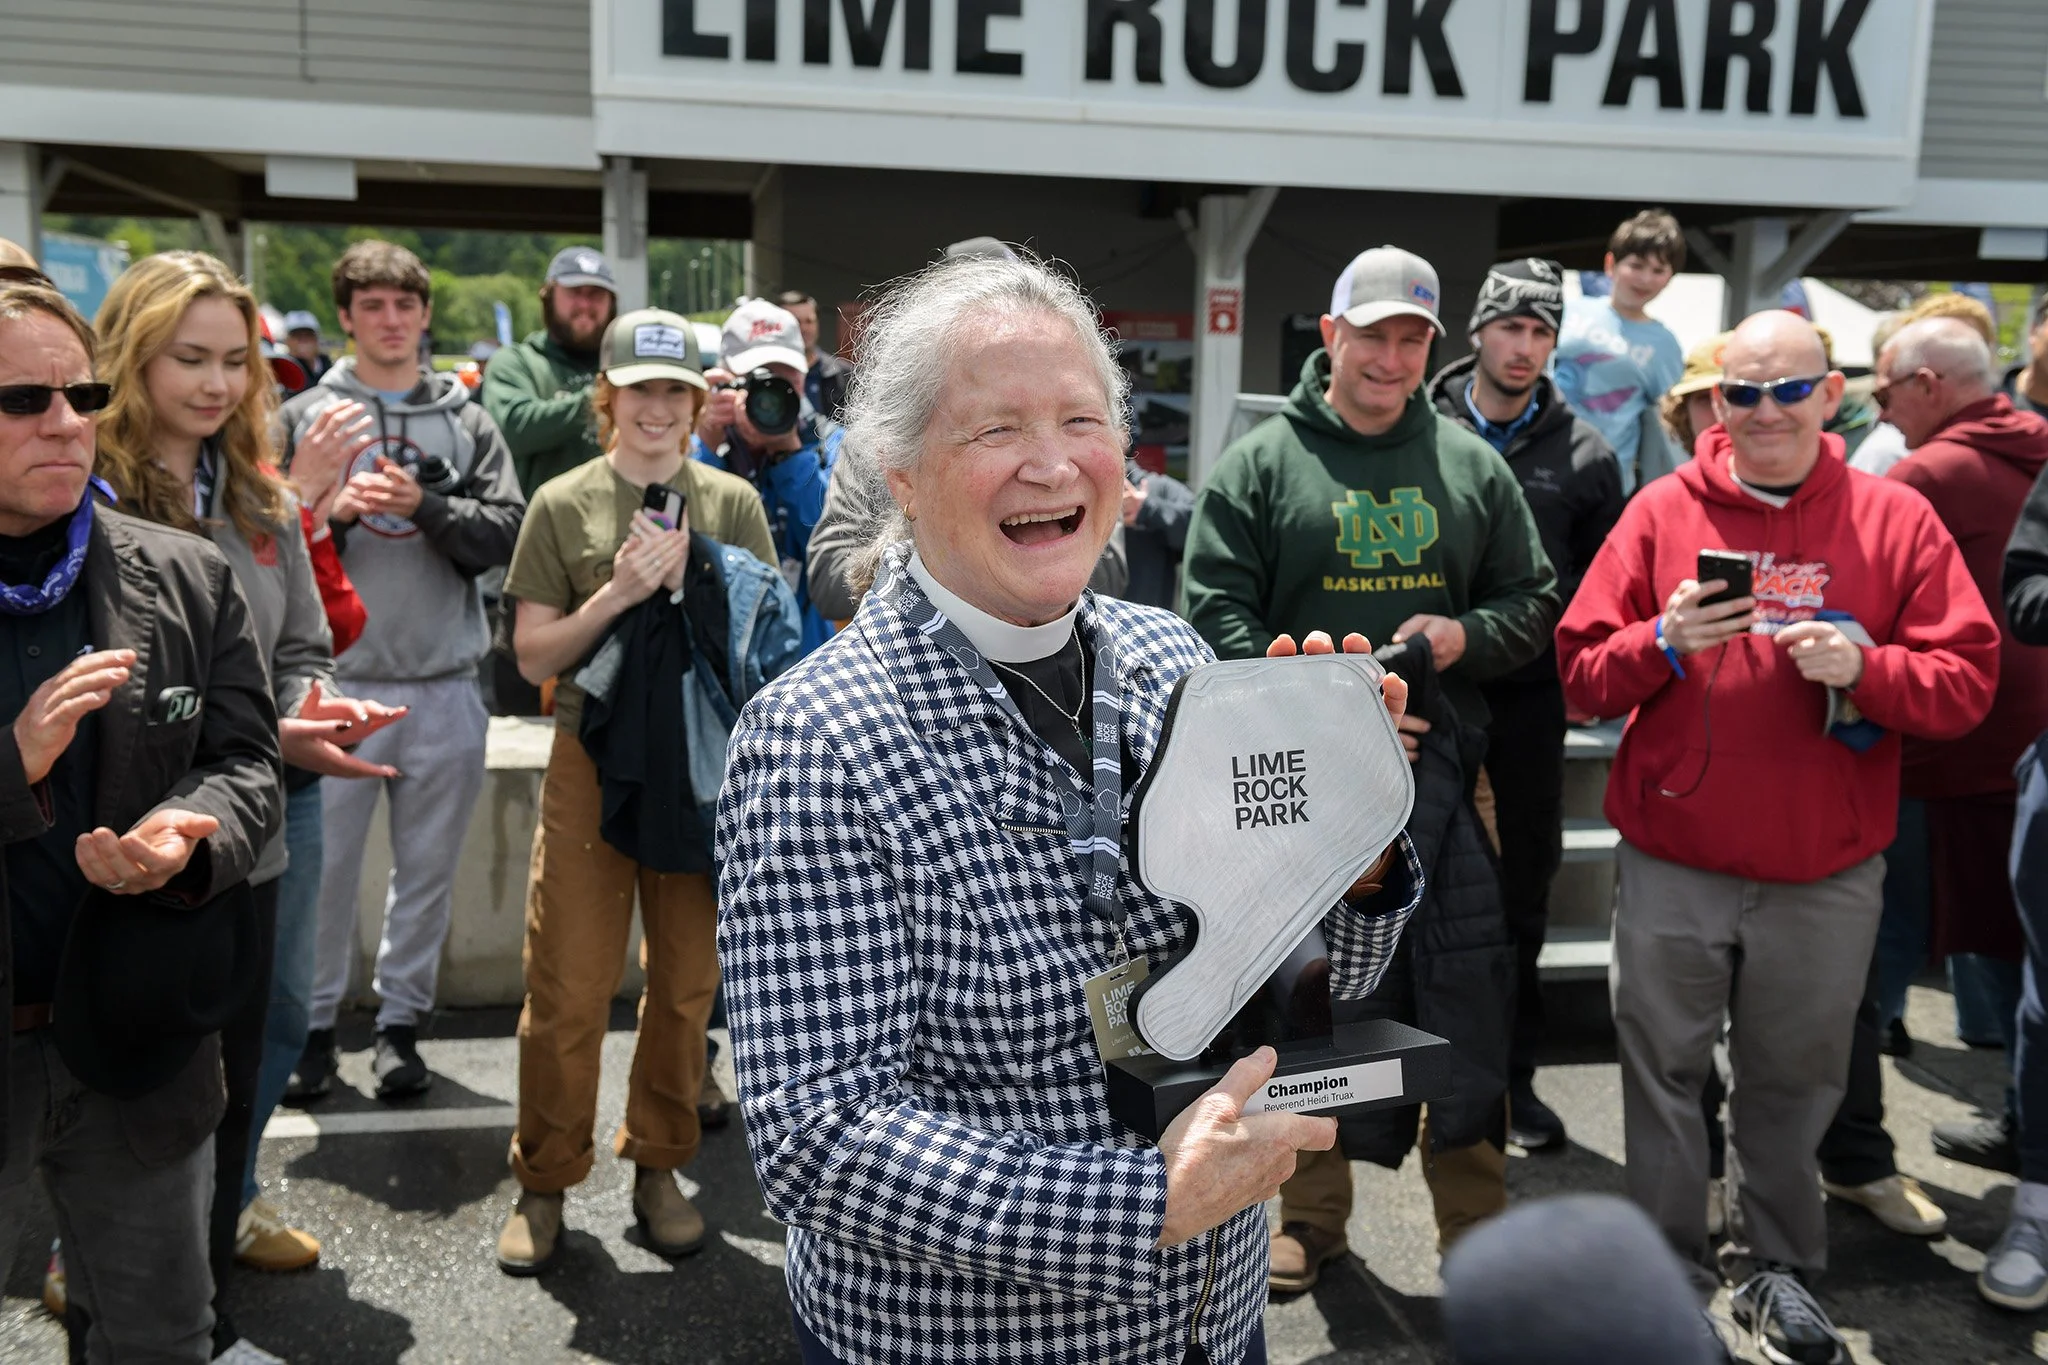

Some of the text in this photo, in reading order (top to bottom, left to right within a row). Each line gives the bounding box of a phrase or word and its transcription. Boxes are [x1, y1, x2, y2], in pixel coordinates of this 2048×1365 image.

[1084, 0, 1466, 98] ROCK
[1523, 0, 1873, 118] PARK
[1322, 573, 1446, 592] BASKETBAL
[898, 594, 916, 610] ROCK
[903, 589, 921, 605] LIME
[1232, 749, 1306, 779] LIME
[1233, 774, 1309, 804] ROCK
[1235, 800, 1310, 830] PARK
[1092, 870, 1103, 896] LIME
[1099, 873, 1109, 898] ROCK
[1105, 877, 1115, 900] PARK
[1102, 980, 1135, 1006] LIME
[1105, 996, 1129, 1017] ROC
[1267, 1076, 1348, 1098] Champion
[1264, 1091, 1354, 1112] Reverend Heidi Truax
